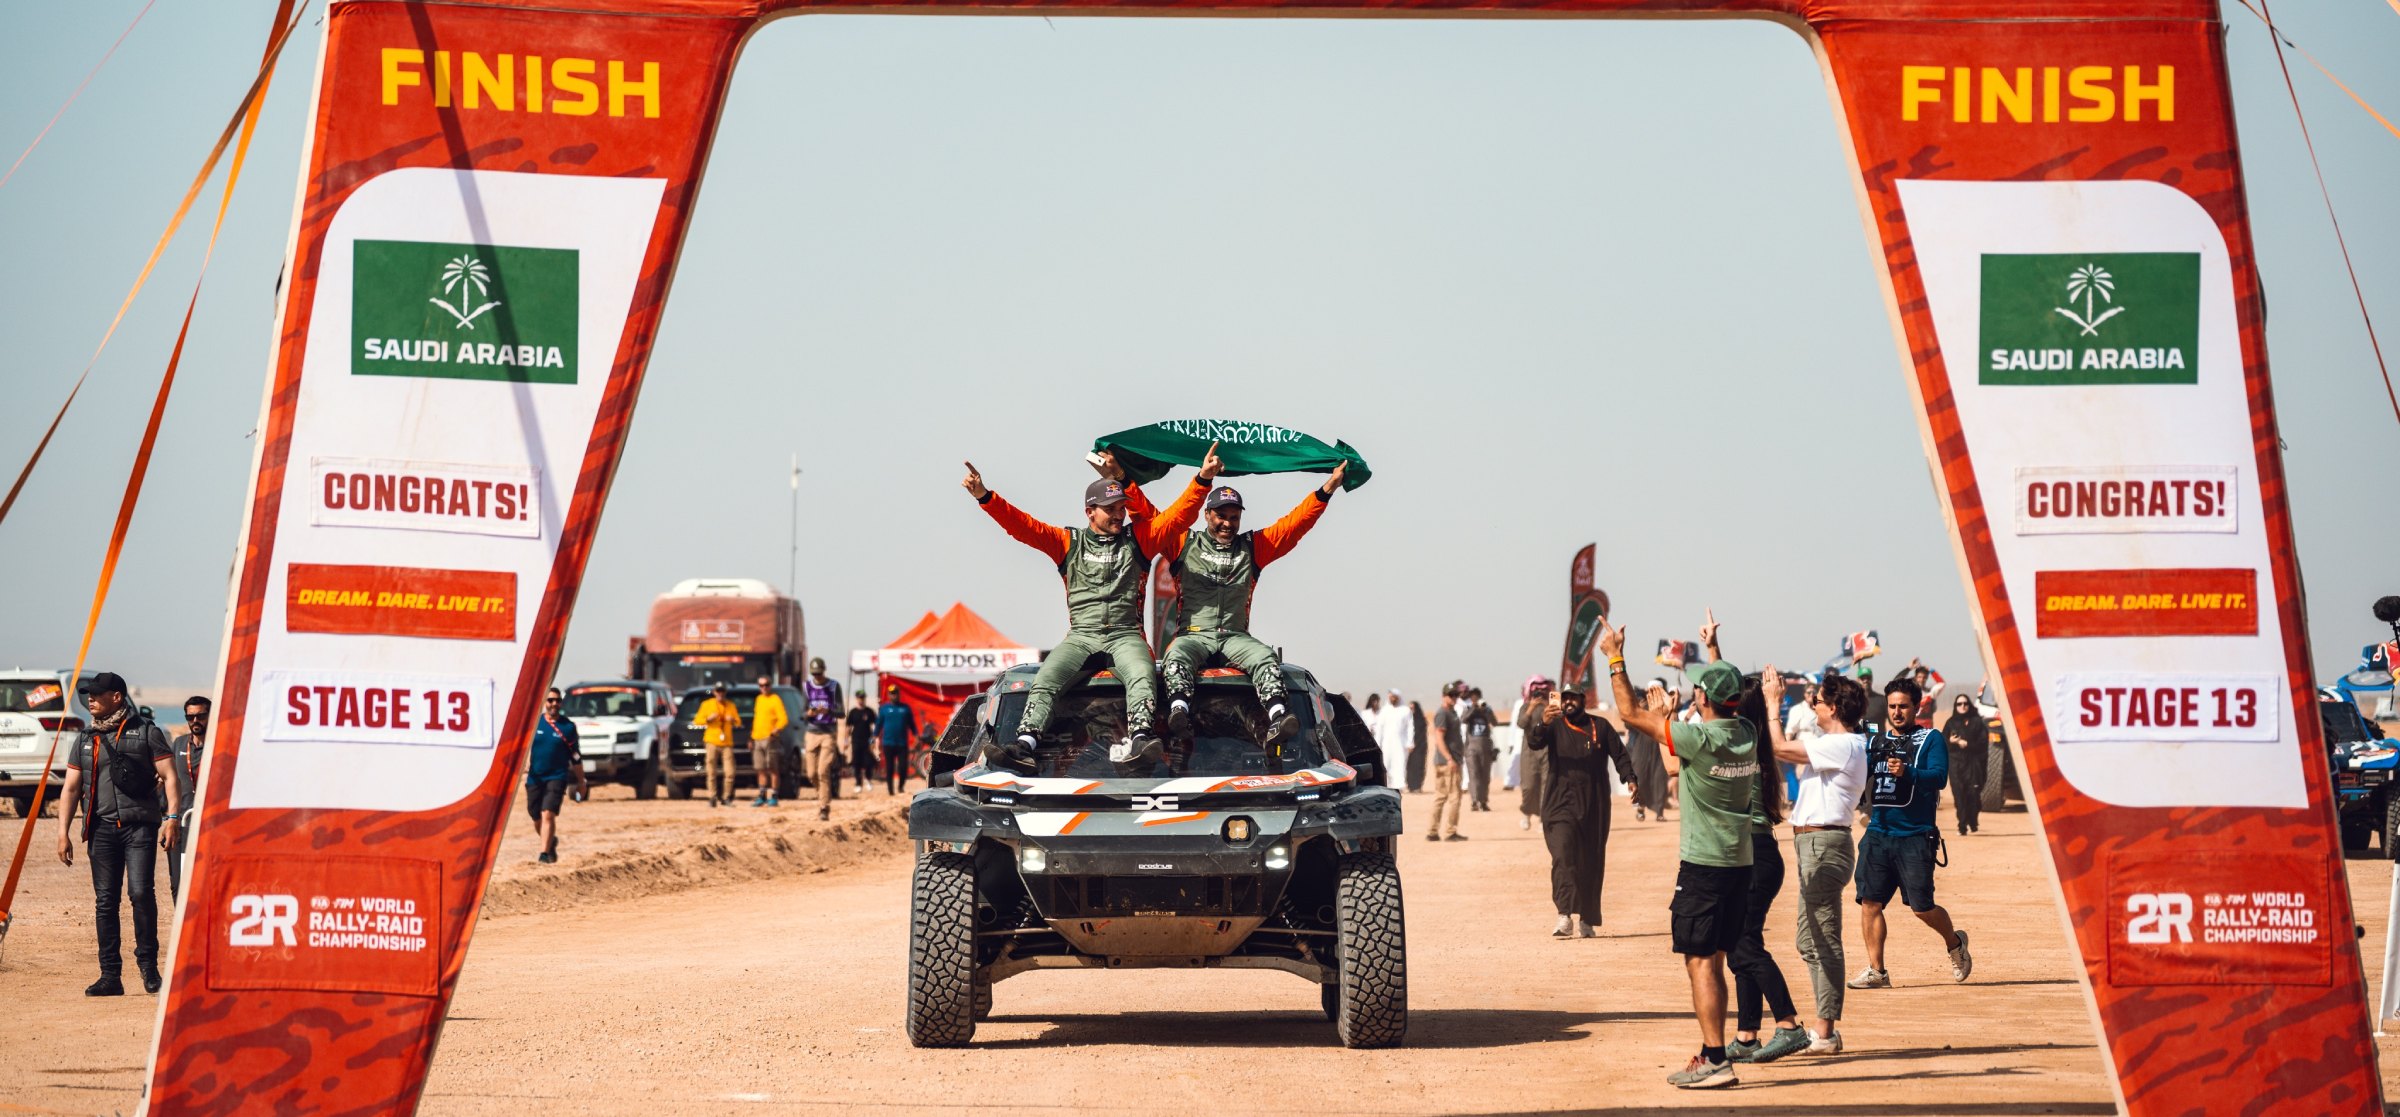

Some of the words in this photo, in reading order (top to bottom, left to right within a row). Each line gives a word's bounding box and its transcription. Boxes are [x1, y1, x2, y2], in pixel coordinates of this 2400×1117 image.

[381, 47, 661, 119] FINISH
[1901, 65, 2175, 124] FINISH
[364, 338, 448, 363] SAUDI
[456, 341, 564, 368] ARABIA
[1991, 348, 2074, 370] SAUDI
[2080, 348, 2186, 370] ARABIA
[324, 472, 528, 521] CONGRATS!
[2027, 480, 2225, 518] CONGRATS!
[298, 589, 373, 607] DREAM.
[376, 592, 434, 610] DARE.
[436, 595, 480, 612] LIVE
[482, 597, 505, 613] IT.
[2045, 595, 2119, 611] DREAM.
[2121, 594, 2177, 610] DARE.
[2180, 593, 2223, 609] LIVE
[2224, 593, 2247, 609] IT.
[920, 654, 997, 668] TUDOR
[287, 686, 411, 730] STAGE
[422, 690, 471, 732] 13
[2080, 688, 2200, 727] STAGE
[2211, 688, 2257, 728] 13
[1875, 777, 1897, 793] 15
[361, 896, 415, 914] WORLD
[2252, 892, 2305, 907] WORLD
[309, 912, 423, 935] RALLY-RAID
[2203, 908, 2314, 927] RALLY-RAID
[308, 932, 426, 952] CHAMPIONSHIP
[2204, 928, 2317, 943] CHAMPIONSHIP
